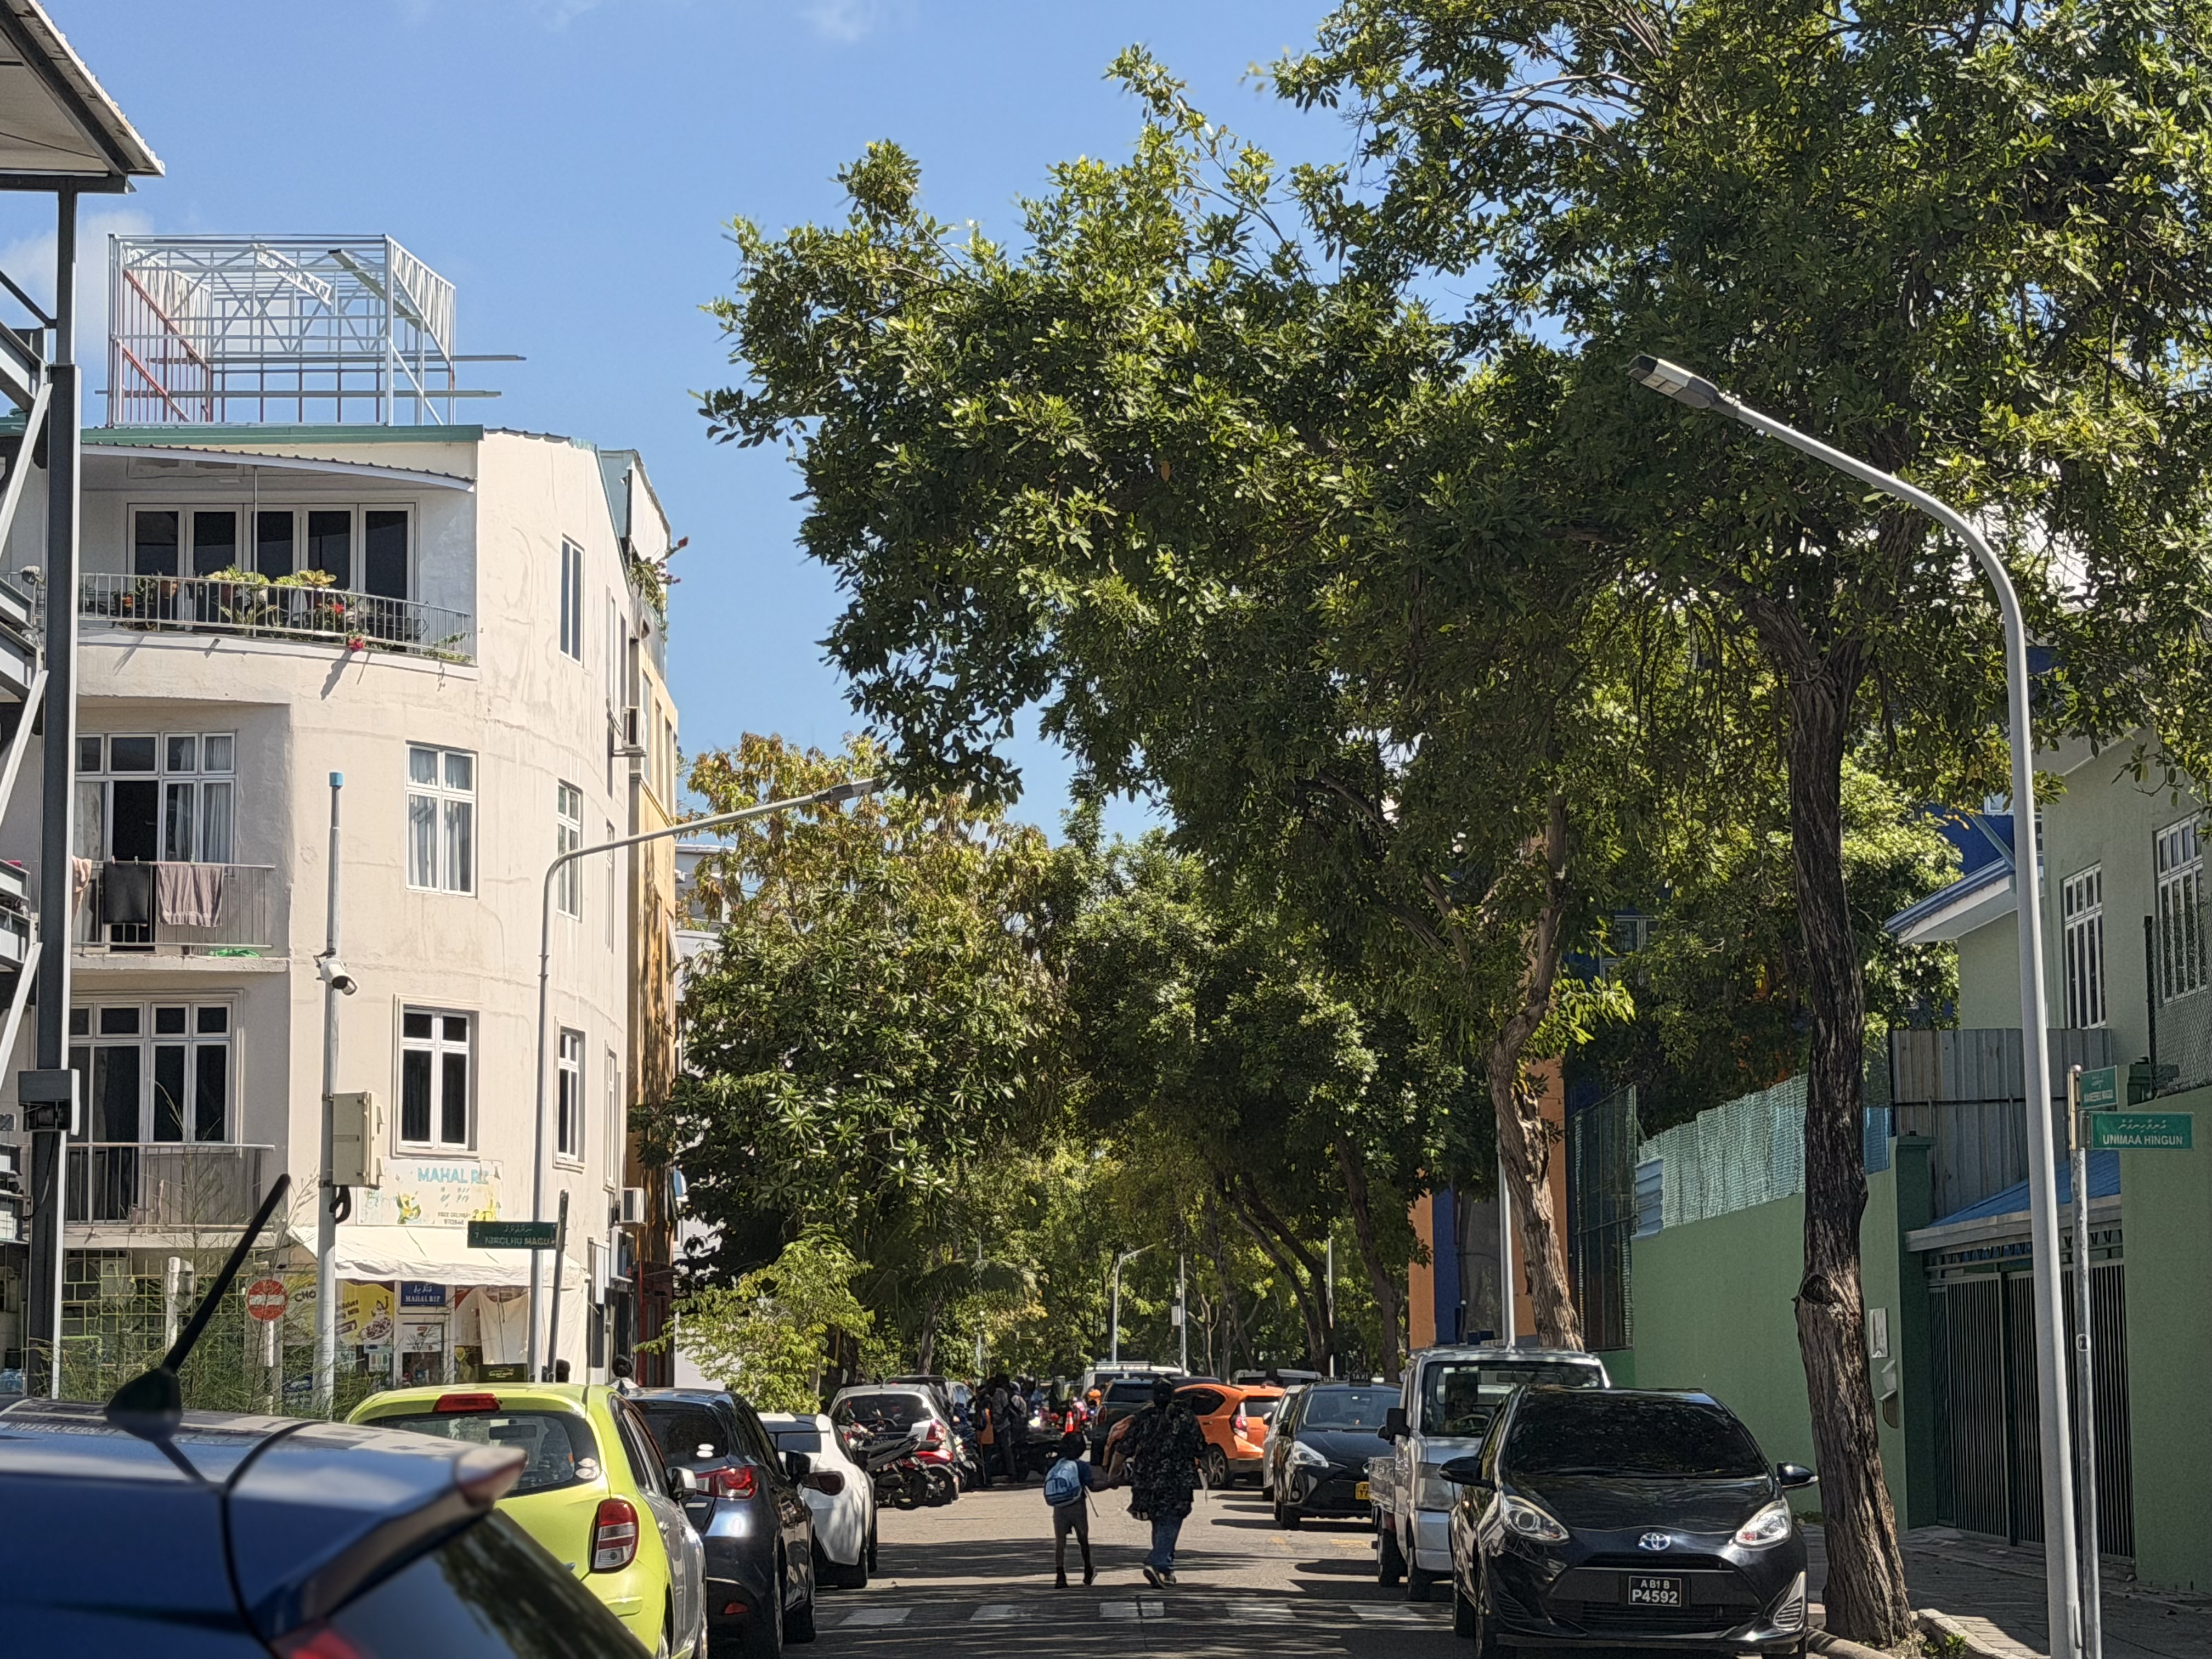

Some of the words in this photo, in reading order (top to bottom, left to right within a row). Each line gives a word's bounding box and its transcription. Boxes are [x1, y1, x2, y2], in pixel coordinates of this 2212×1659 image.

[2102, 1134, 2143, 1145] UNIMAA
[2144, 1135, 2183, 1146] HINGUN
[417, 1167, 468, 1183] MAHAL
[1632, 1589, 1678, 1604] P4592
